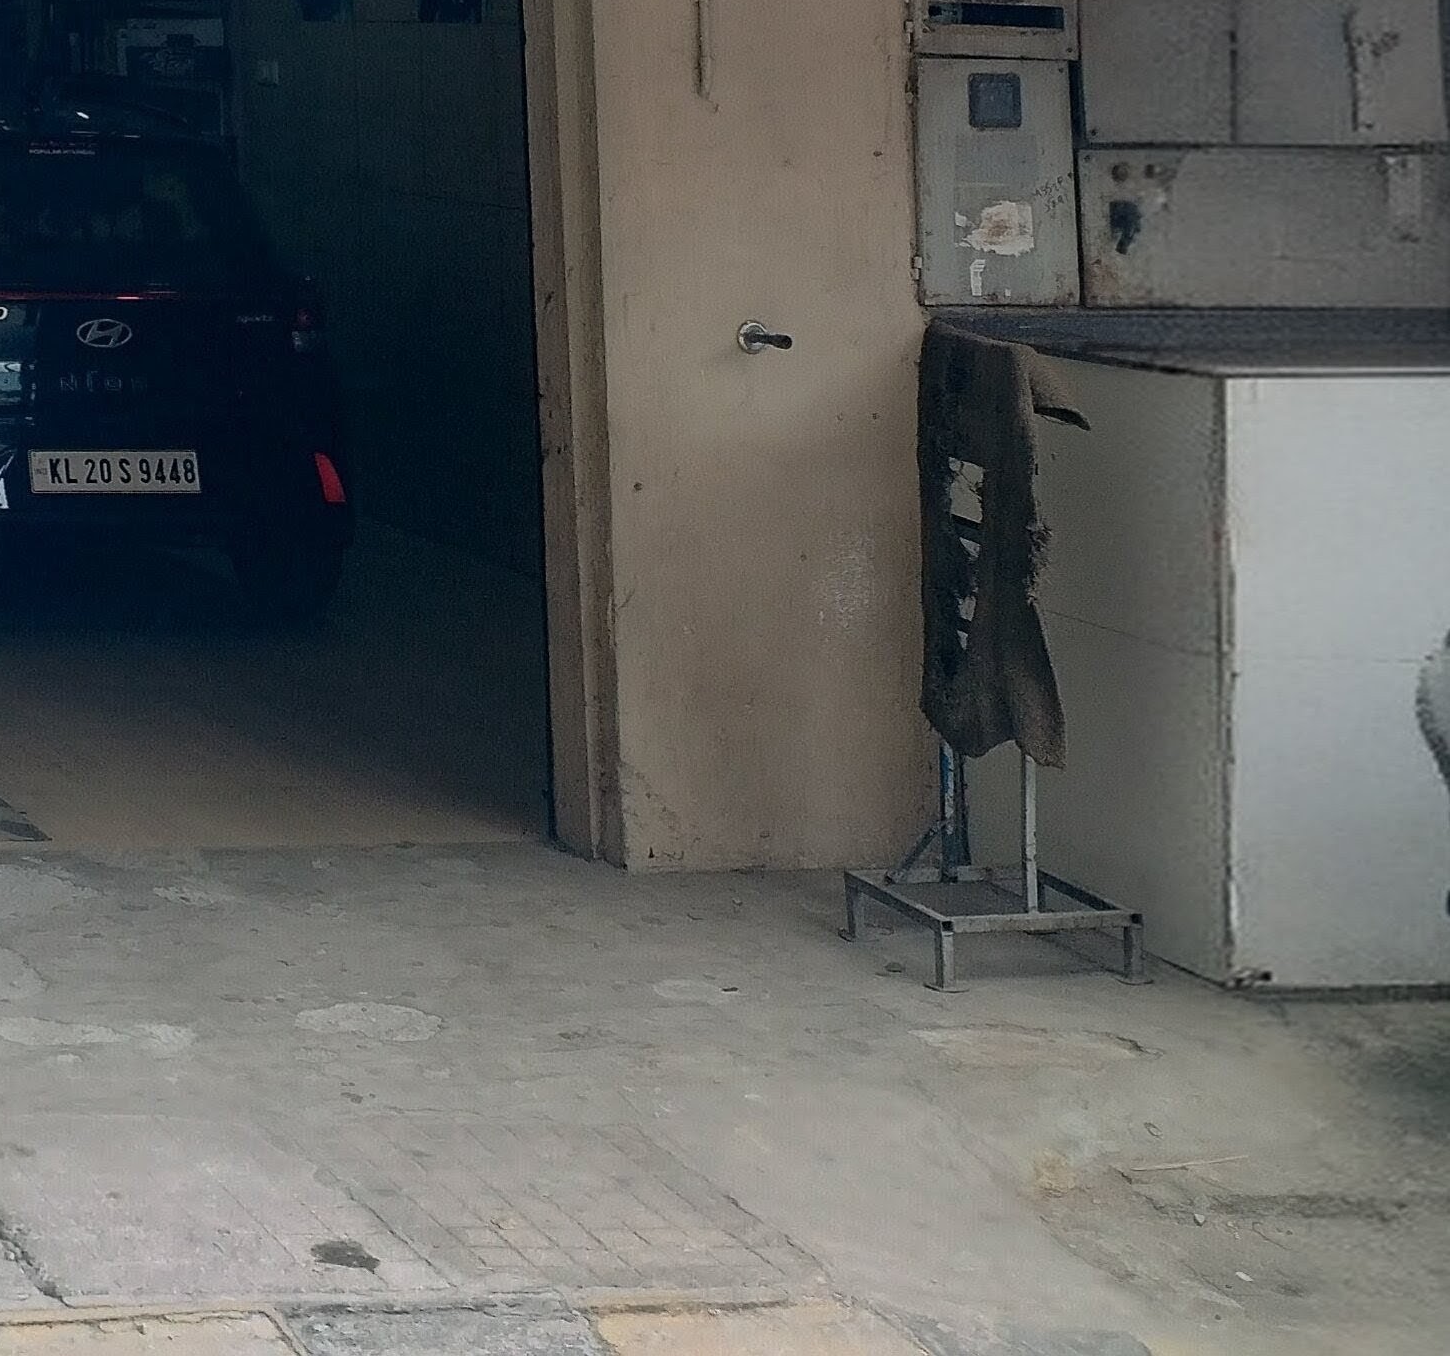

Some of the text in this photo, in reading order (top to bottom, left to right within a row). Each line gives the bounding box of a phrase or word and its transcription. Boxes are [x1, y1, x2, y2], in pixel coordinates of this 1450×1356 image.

[49, 458, 196, 484] KL 20 S 9448
